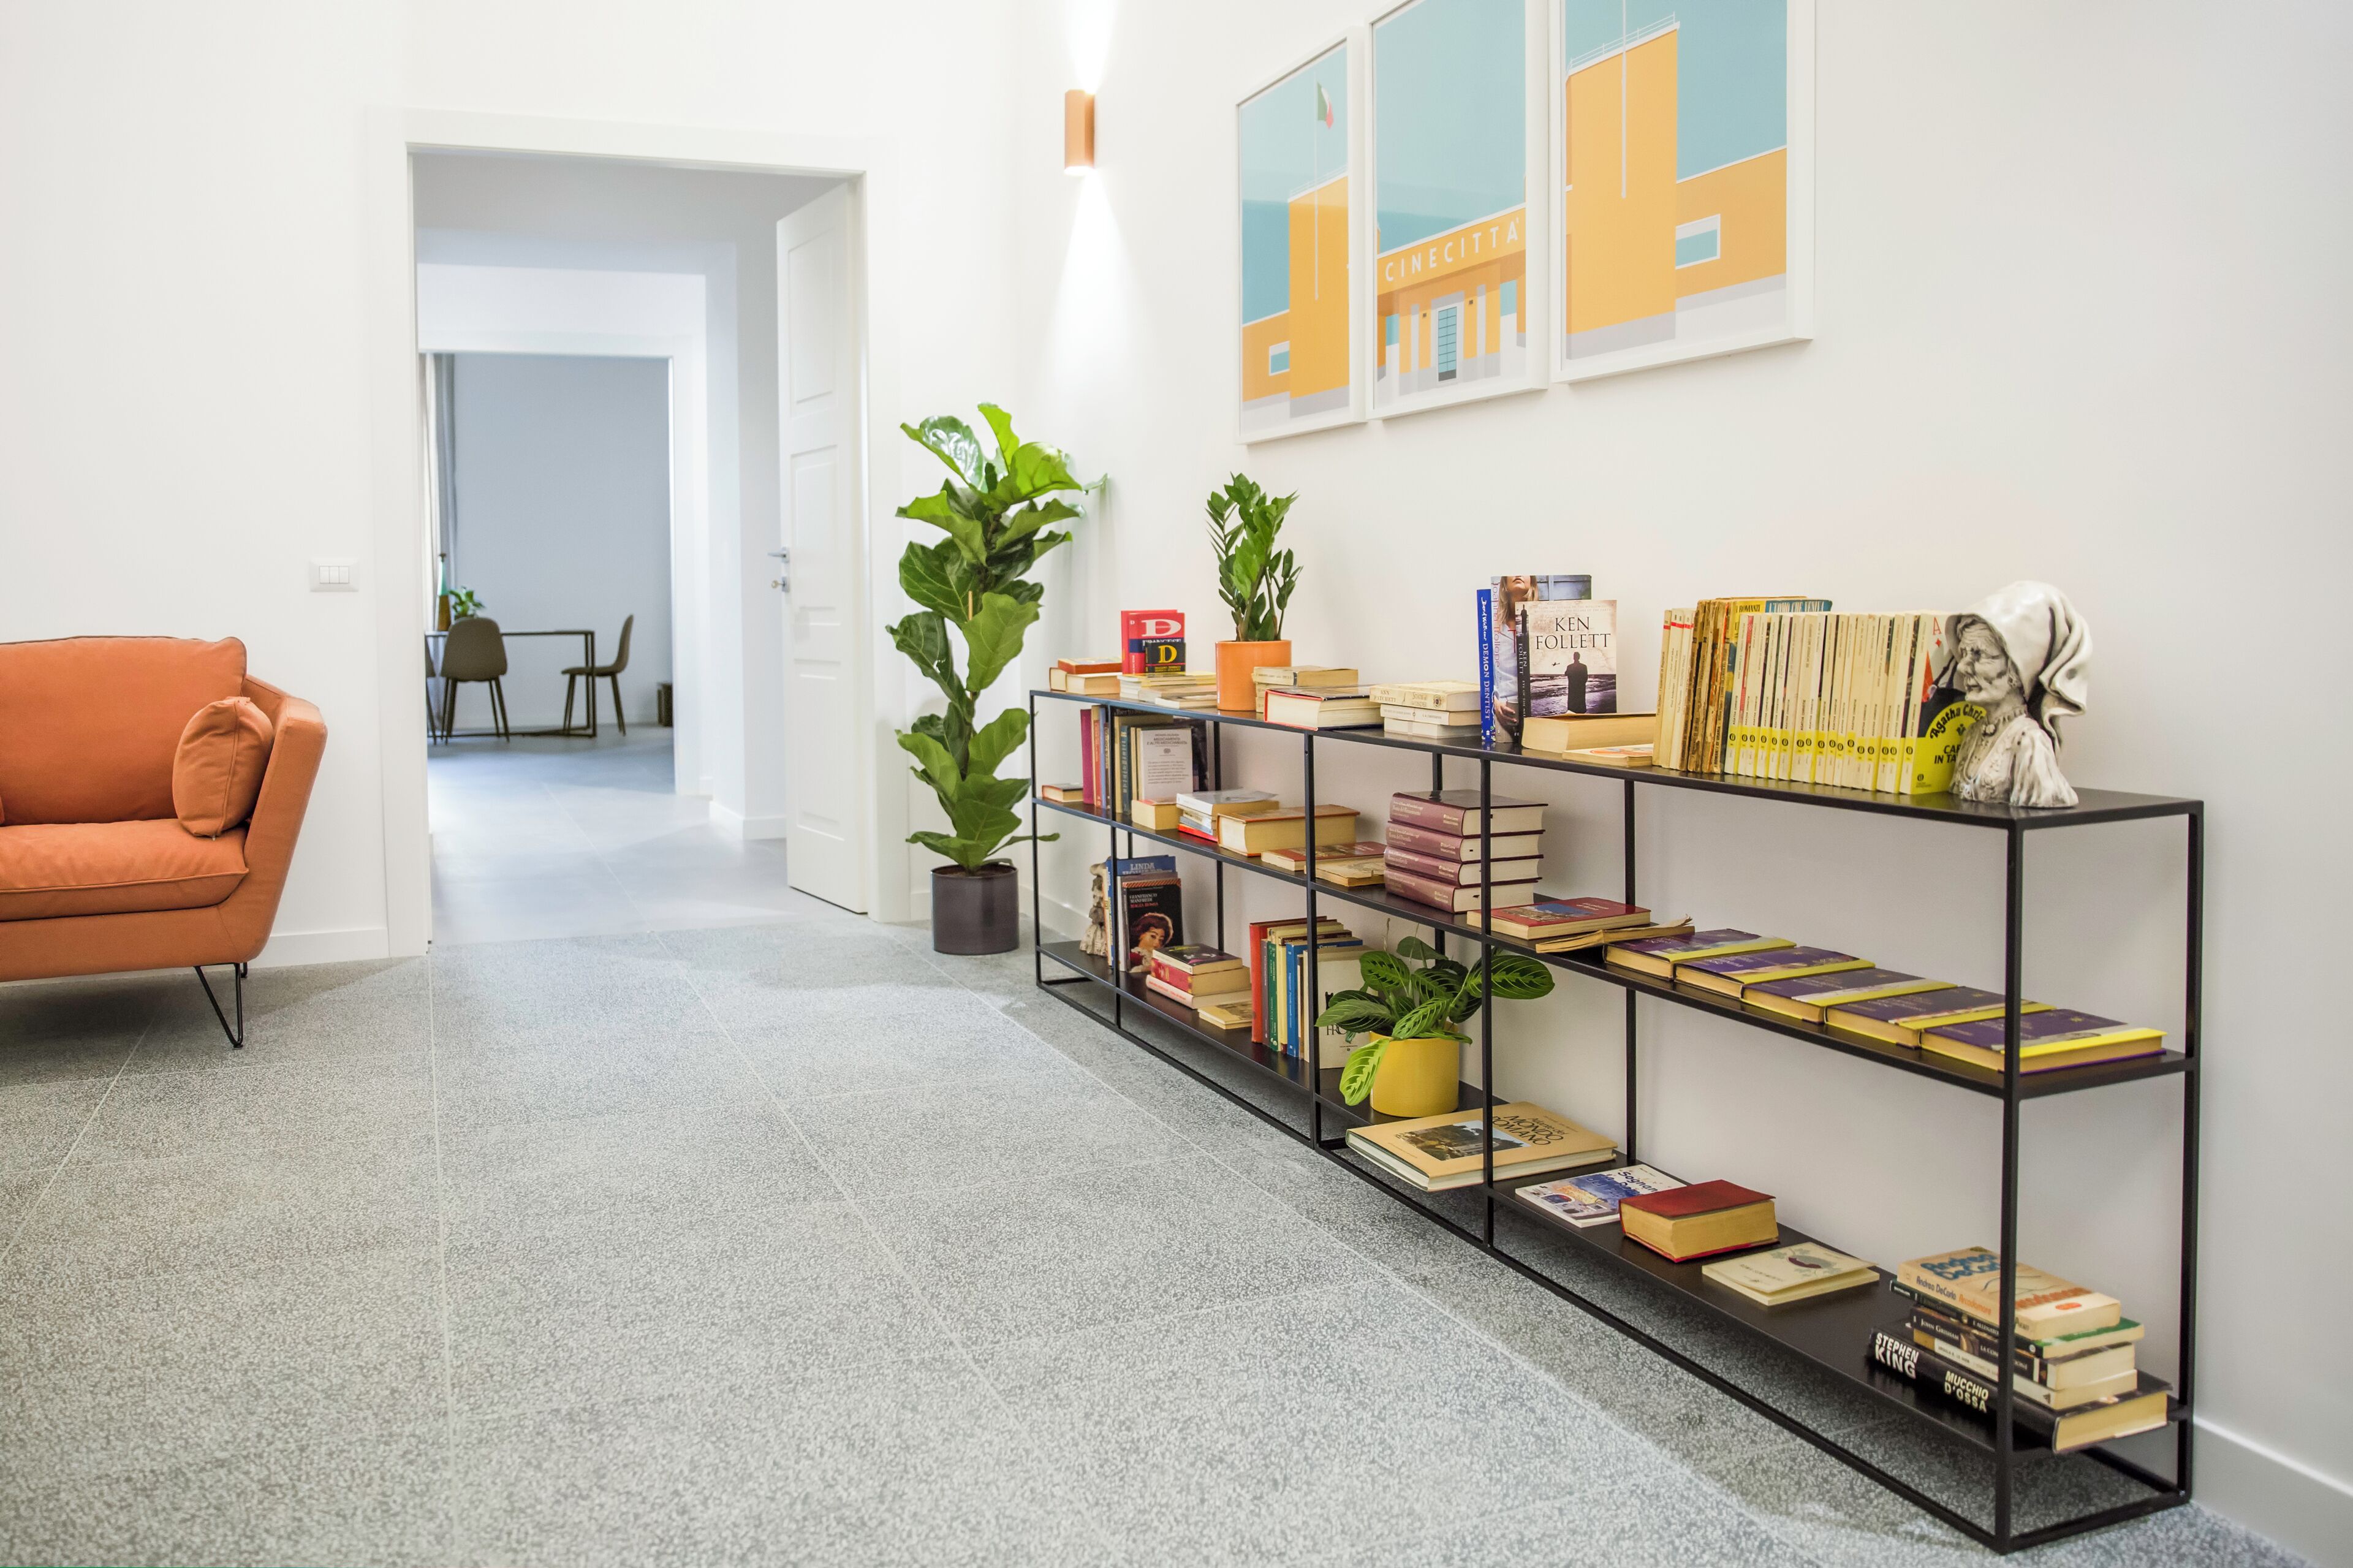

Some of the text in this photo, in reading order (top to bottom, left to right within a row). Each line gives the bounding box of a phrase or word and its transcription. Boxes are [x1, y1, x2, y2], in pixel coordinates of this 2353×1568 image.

[1490, 582, 1499, 621] Joanna
[1141, 619, 1182, 637] D
[1555, 616, 1590, 632] KEN
[1536, 634, 1611, 650] FOLLETT
[1158, 645, 1177, 663] D
[1930, 703, 1984, 739] Agatha Chris
[1934, 754, 1944, 764] IN
[1503, 1116, 1563, 1140] MONDO
[1920, 1254, 1997, 1271] Andrea
[1916, 1276, 1934, 1292] Andrea
[1921, 1319, 1935, 1330] JOHN
[1935, 1325, 1959, 1341] GRISHAM
[1876, 1332, 1919, 1363] STEPHEN
[1875, 1344, 1917, 1379] KING
[1945, 1371, 1989, 1401] MUCCHIO
[1944, 1381, 1987, 1414] D'OSSA
